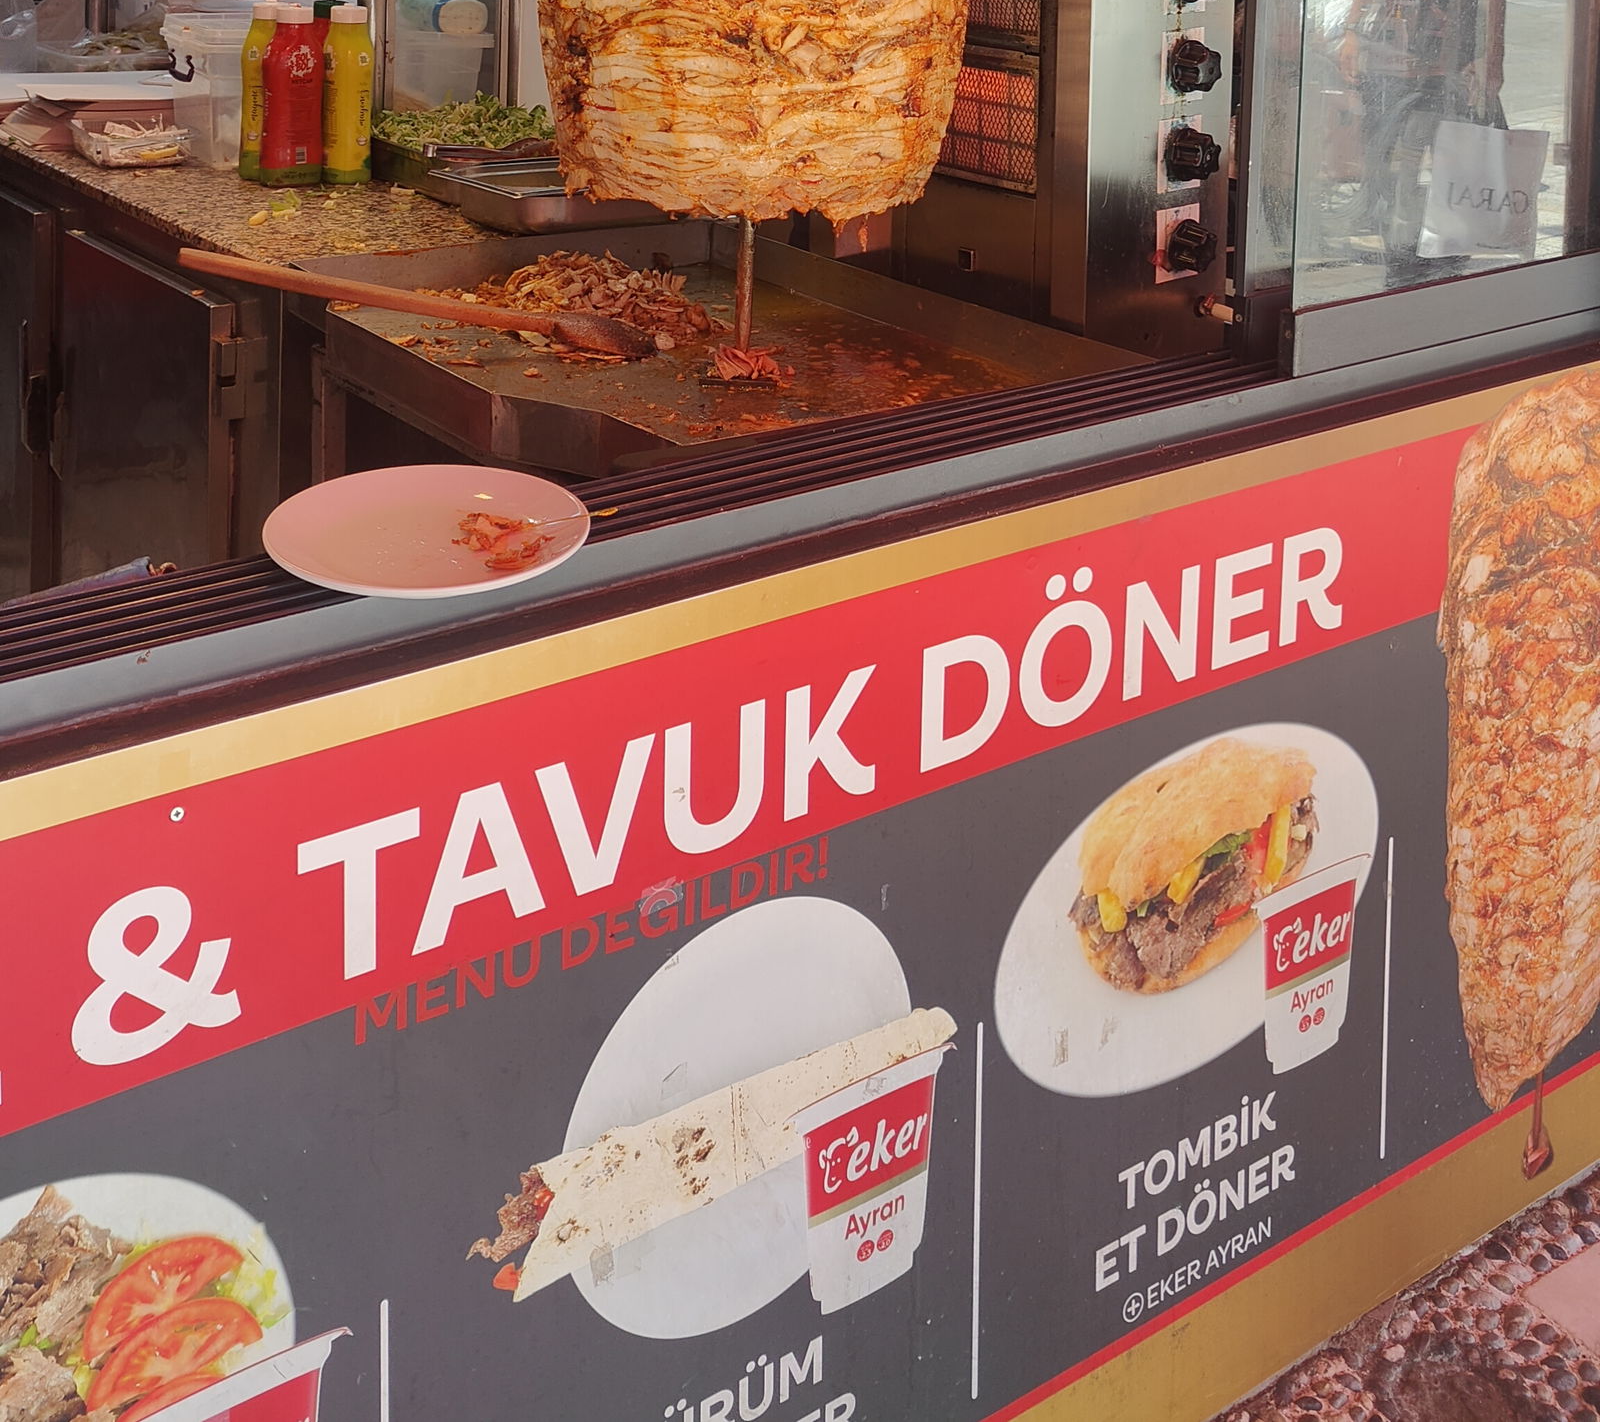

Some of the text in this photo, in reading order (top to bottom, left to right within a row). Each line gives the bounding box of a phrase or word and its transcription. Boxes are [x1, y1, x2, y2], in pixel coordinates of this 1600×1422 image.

[71, 527, 1343, 1066] & TAVUK DÖNER
[1291, 979, 1334, 1013] Ayran
[1118, 1090, 1277, 1210] TOMBİK
[844, 1194, 905, 1240] Ayran
[1095, 1144, 1296, 1292] ET DÖNER
[1147, 1216, 1272, 1309] EKER AYRAN
